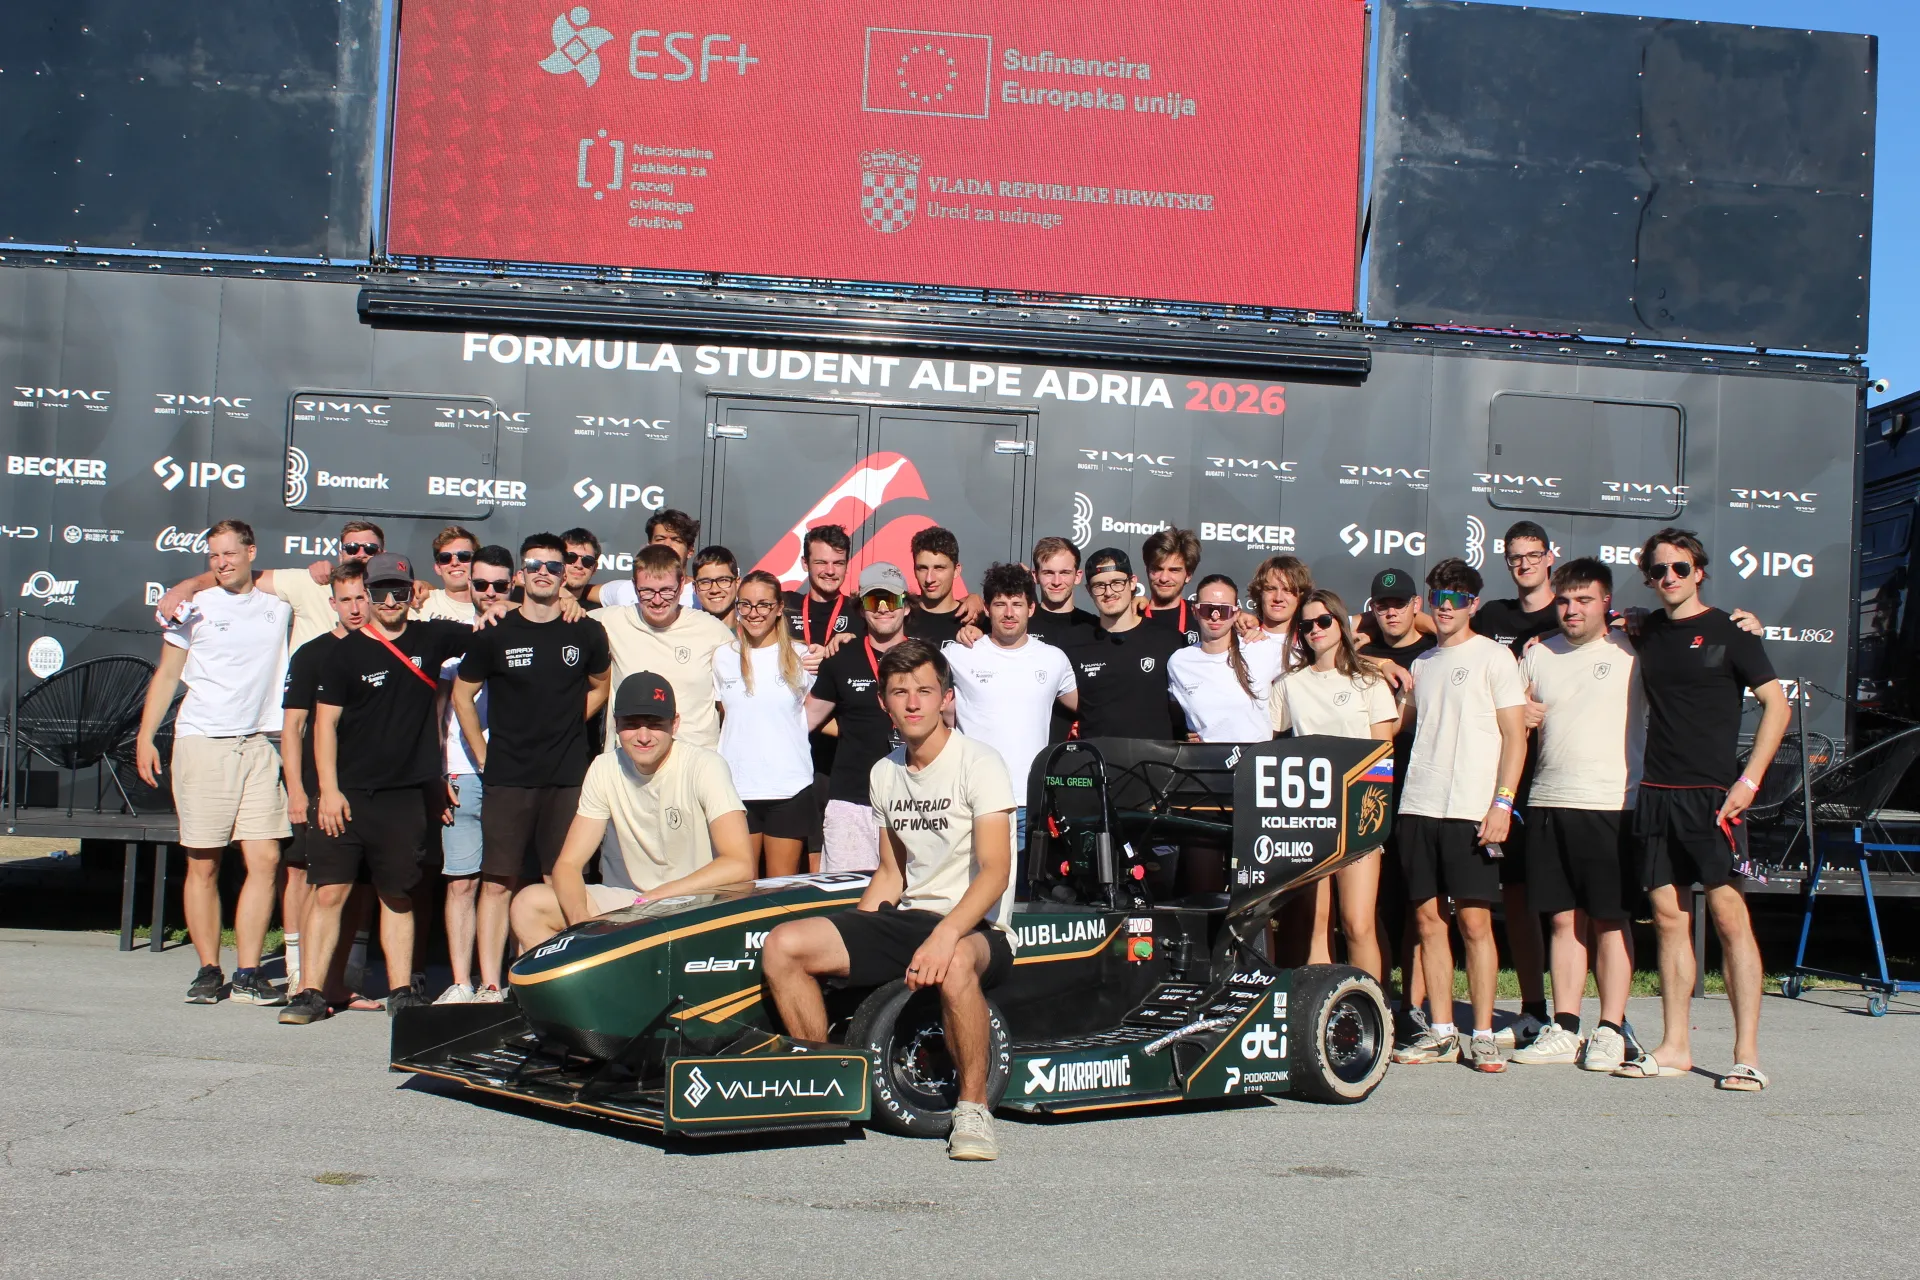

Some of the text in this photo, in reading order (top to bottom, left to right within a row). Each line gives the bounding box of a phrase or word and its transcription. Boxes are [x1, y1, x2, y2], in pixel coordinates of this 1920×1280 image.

[628, 29, 760, 83] ESF+
[1002, 47, 1151, 81] Sufinancira
[1001, 81, 1196, 120] Europska unija
[630, 161, 707, 177] zaklada za
[630, 181, 675, 196] razvoj
[927, 175, 1215, 212] VLADA REPUBLIKE HRVATSKE
[629, 198, 695, 215] civilnoga
[926, 201, 1064, 230] Ured za udruge
[463, 331, 1287, 416] FORMULA STUDENT ALPE ADRIA 2026
[14, 386, 111, 401] RIMAC
[155, 393, 253, 408] RIMAC
[295, 400, 392, 415] RIMAC
[435, 407, 531, 422] RIMAC
[575, 415, 671, 430] RIMAC
[1079, 448, 1176, 466] RIMAC
[1206, 456, 1298, 471] RIMAC
[7, 455, 107, 479] BECKER
[189, 461, 246, 490] IPG
[1340, 464, 1431, 479] RIMAC
[55, 477, 74, 485] print
[317, 470, 390, 490] Bomark
[428, 476, 527, 500] BECKER
[1472, 472, 1562, 487] RIMAC
[1602, 481, 1690, 495] RIMAC
[608, 482, 665, 511] IPG
[1730, 488, 1818, 502] RIMAC
[1200, 521, 1296, 545] BECKER
[284, 535, 341, 557] FLiX
[1247, 543, 1265, 551] print
[1373, 529, 1426, 557] IPG
[1762, 551, 1814, 578] IPG
[1798, 628, 1834, 643] 1862
[514, 658, 532, 667] ELES
[1046, 776, 1093, 787] TSAL GREEN
[1255, 755, 1333, 809] E69
[889, 800, 893, 812] I
[893, 818, 909, 832] OF
[1261, 816, 1337, 829] KOLEKTOR
[1274, 841, 1314, 858] SILIKO
[1252, 870, 1265, 884] FS
[1017, 917, 1107, 948] JUBLJANA
[1128, 918, 1152, 932] HVD
[684, 956, 756, 973] elan
[1241, 1023, 1288, 1060] dti
[1058, 1054, 1131, 1092] AKRAPOVIČ
[716, 1078, 845, 1100] VALHALLA
[1243, 1084, 1264, 1094] group
